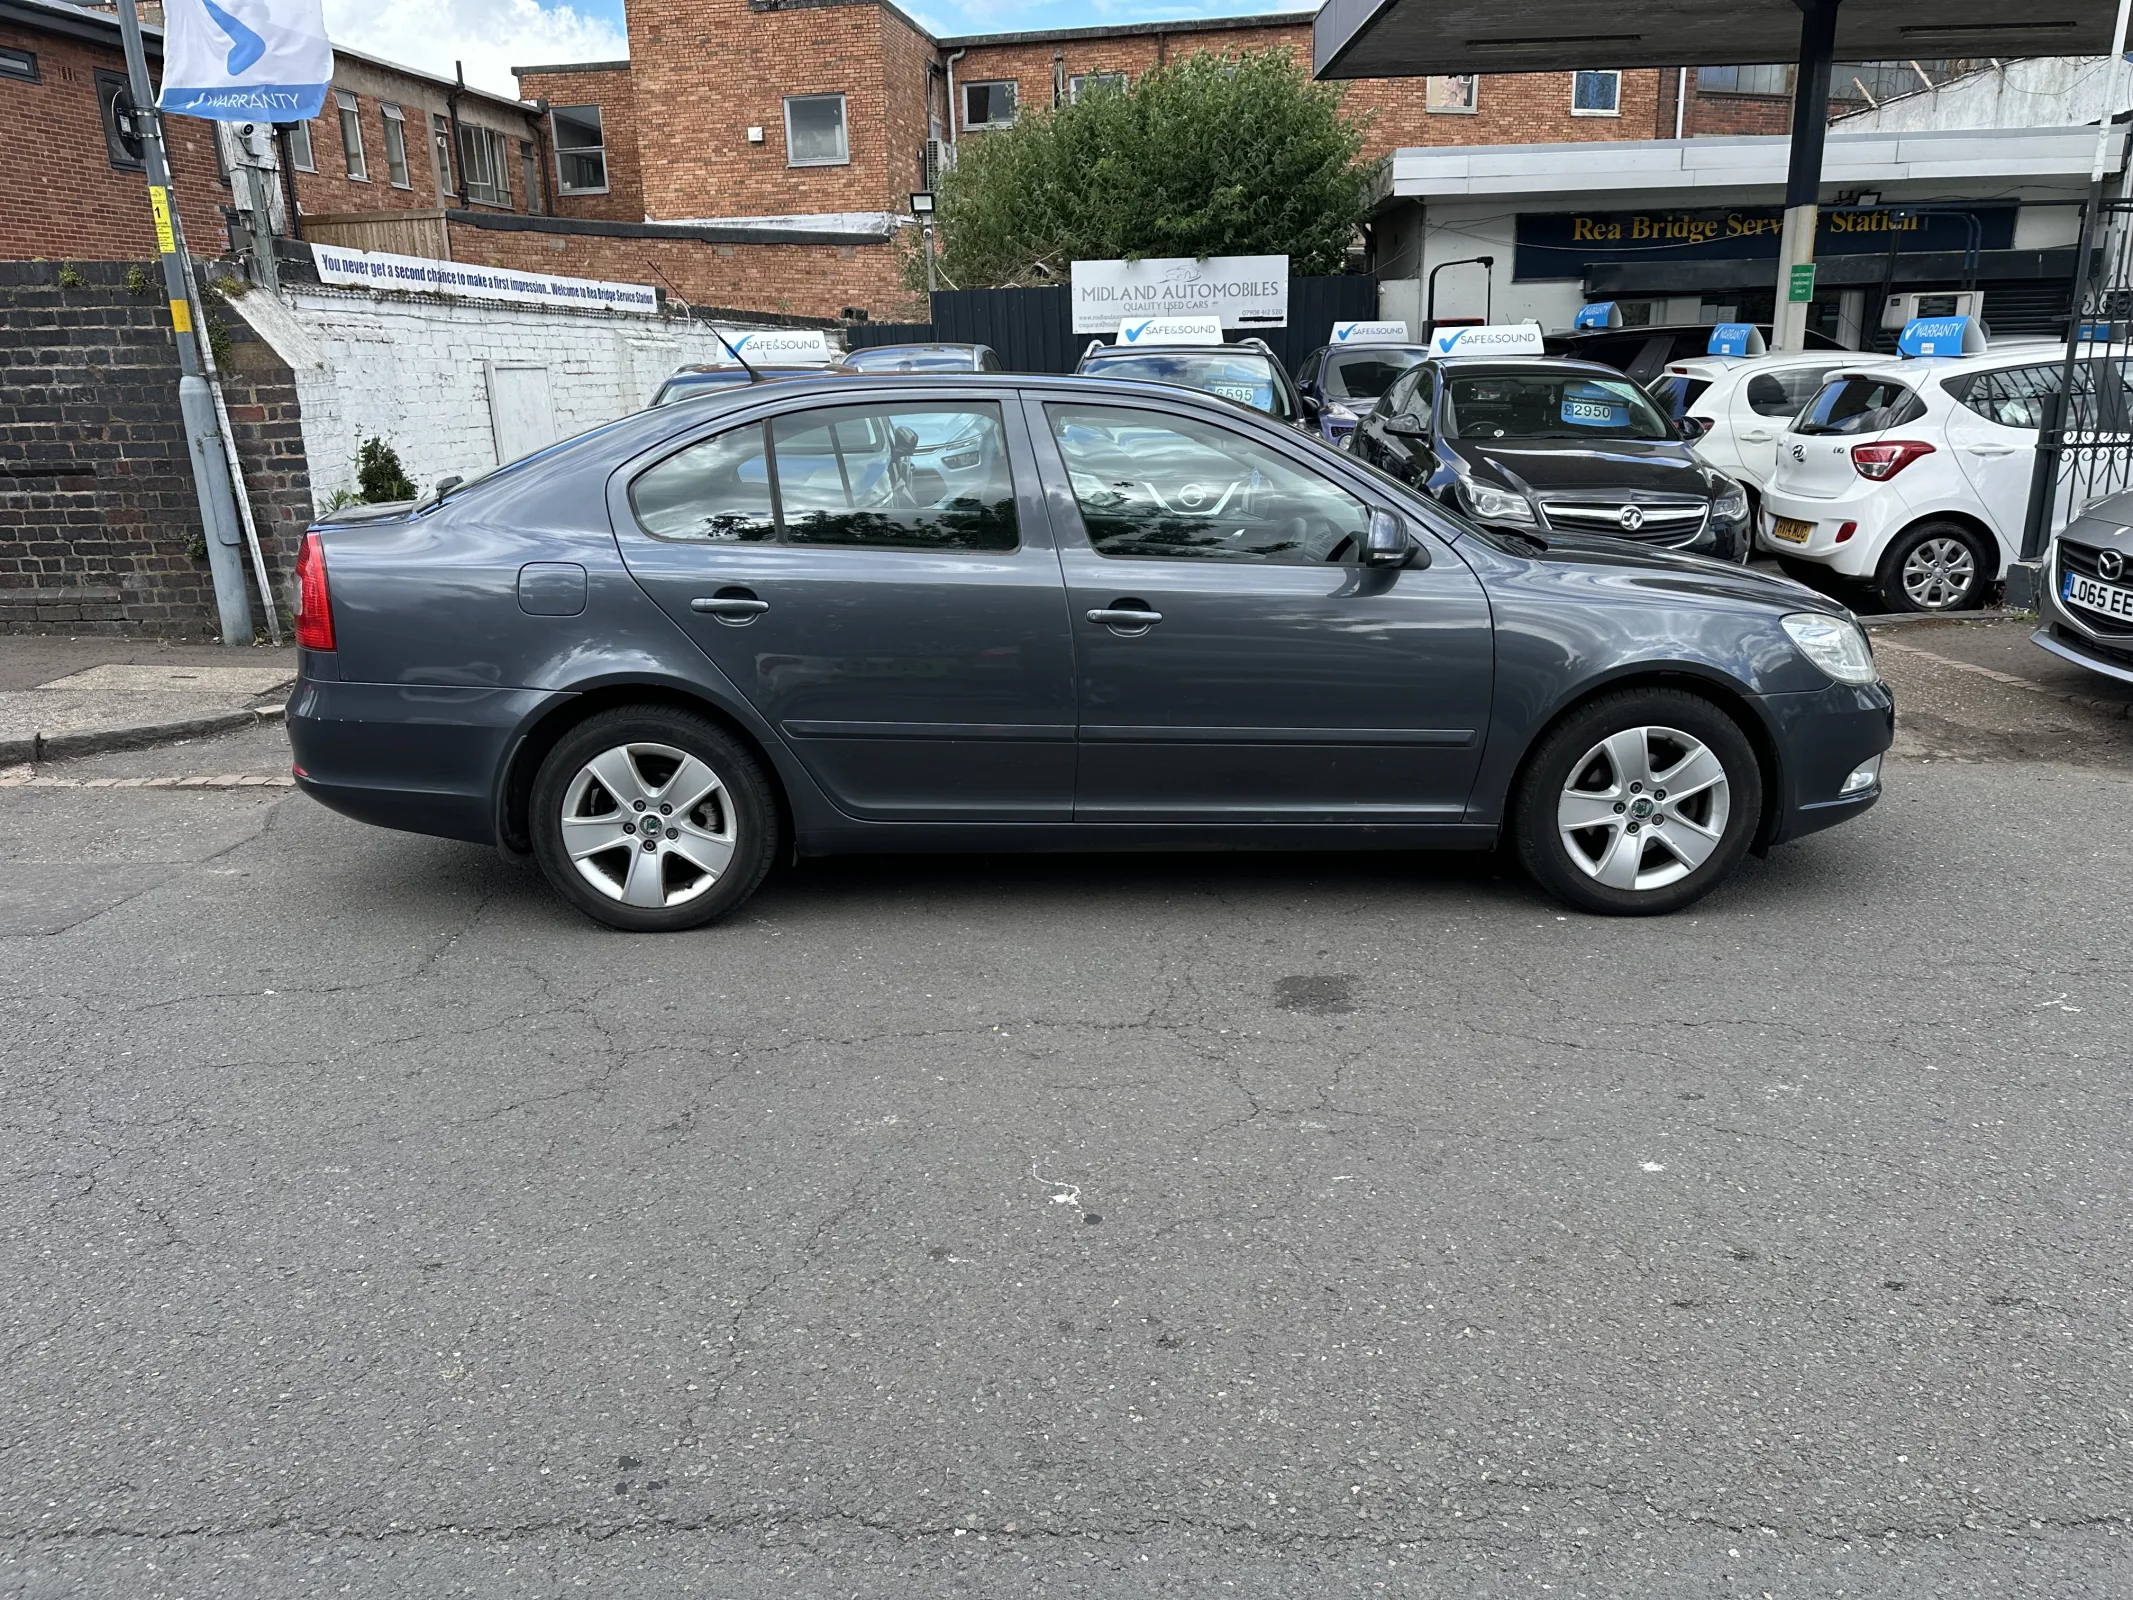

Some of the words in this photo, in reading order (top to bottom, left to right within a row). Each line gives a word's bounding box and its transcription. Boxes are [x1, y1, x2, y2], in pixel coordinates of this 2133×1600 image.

[207, 93, 299, 109] WARRANTY
[1572, 217, 1622, 240] Rea
[1631, 215, 1718, 244] Bridge
[1726, 213, 1818, 236] Serv
[322, 254, 341, 271] You
[342, 259, 369, 275] never
[371, 263, 387, 278] get
[388, 265, 393, 277] a
[395, 265, 426, 282] second
[427, 268, 456, 285] chance
[457, 271, 465, 285] to
[467, 273, 487, 288] make
[488, 277, 493, 288] a
[493, 275, 510, 290] first
[551, 282, 579, 298] Welcome
[580, 286, 586, 298] to
[586, 286, 598, 299] Rea
[597, 288, 616, 302] Bridge
[616, 289, 636, 303] Service
[635, 291, 653, 304] Station
[1082, 285, 1157, 302] MIDLAND
[1162, 282, 1279, 299] AUTOMOBILES
[1123, 301, 1162, 311] QUALITY
[1163, 301, 1186, 310] USED
[1187, 300, 1209, 309] CARS
[1145, 324, 1216, 335] SAFE&SOUND
[1352, 326, 1404, 335] SAFE&SOUND
[1915, 322, 1963, 338] WARRANTY
[746, 339, 820, 350] SAFE&SOUND
[1460, 333, 1536, 345] SAFE&SOUND
[1564, 404, 1610, 418] £2950
